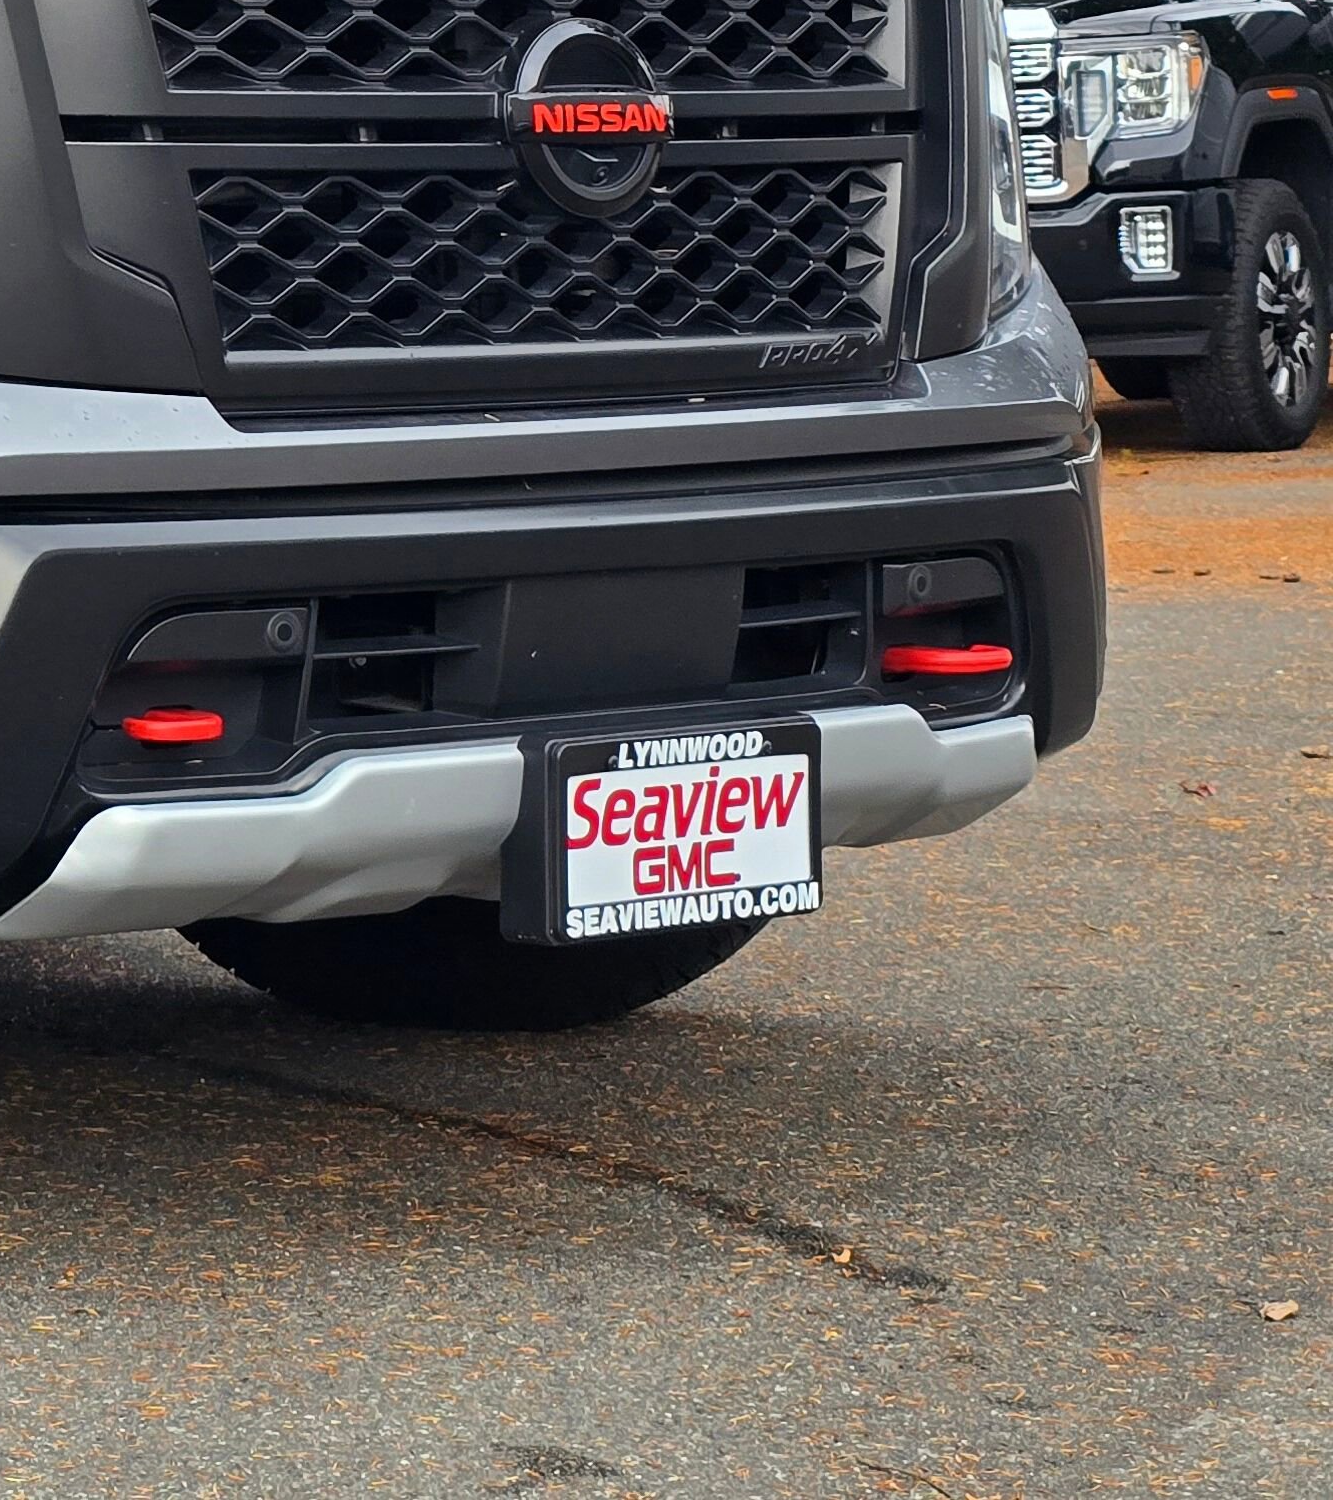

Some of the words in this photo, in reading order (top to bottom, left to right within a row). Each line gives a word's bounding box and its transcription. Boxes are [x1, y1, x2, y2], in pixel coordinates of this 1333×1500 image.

[533, 102, 668, 133] NISSAN
[616, 730, 764, 769] LYNNWOOD
[565, 766, 804, 849] Seaview
[633, 838, 736, 896] GMC
[566, 882, 820, 939] SEAVIEWAUTO.COM
